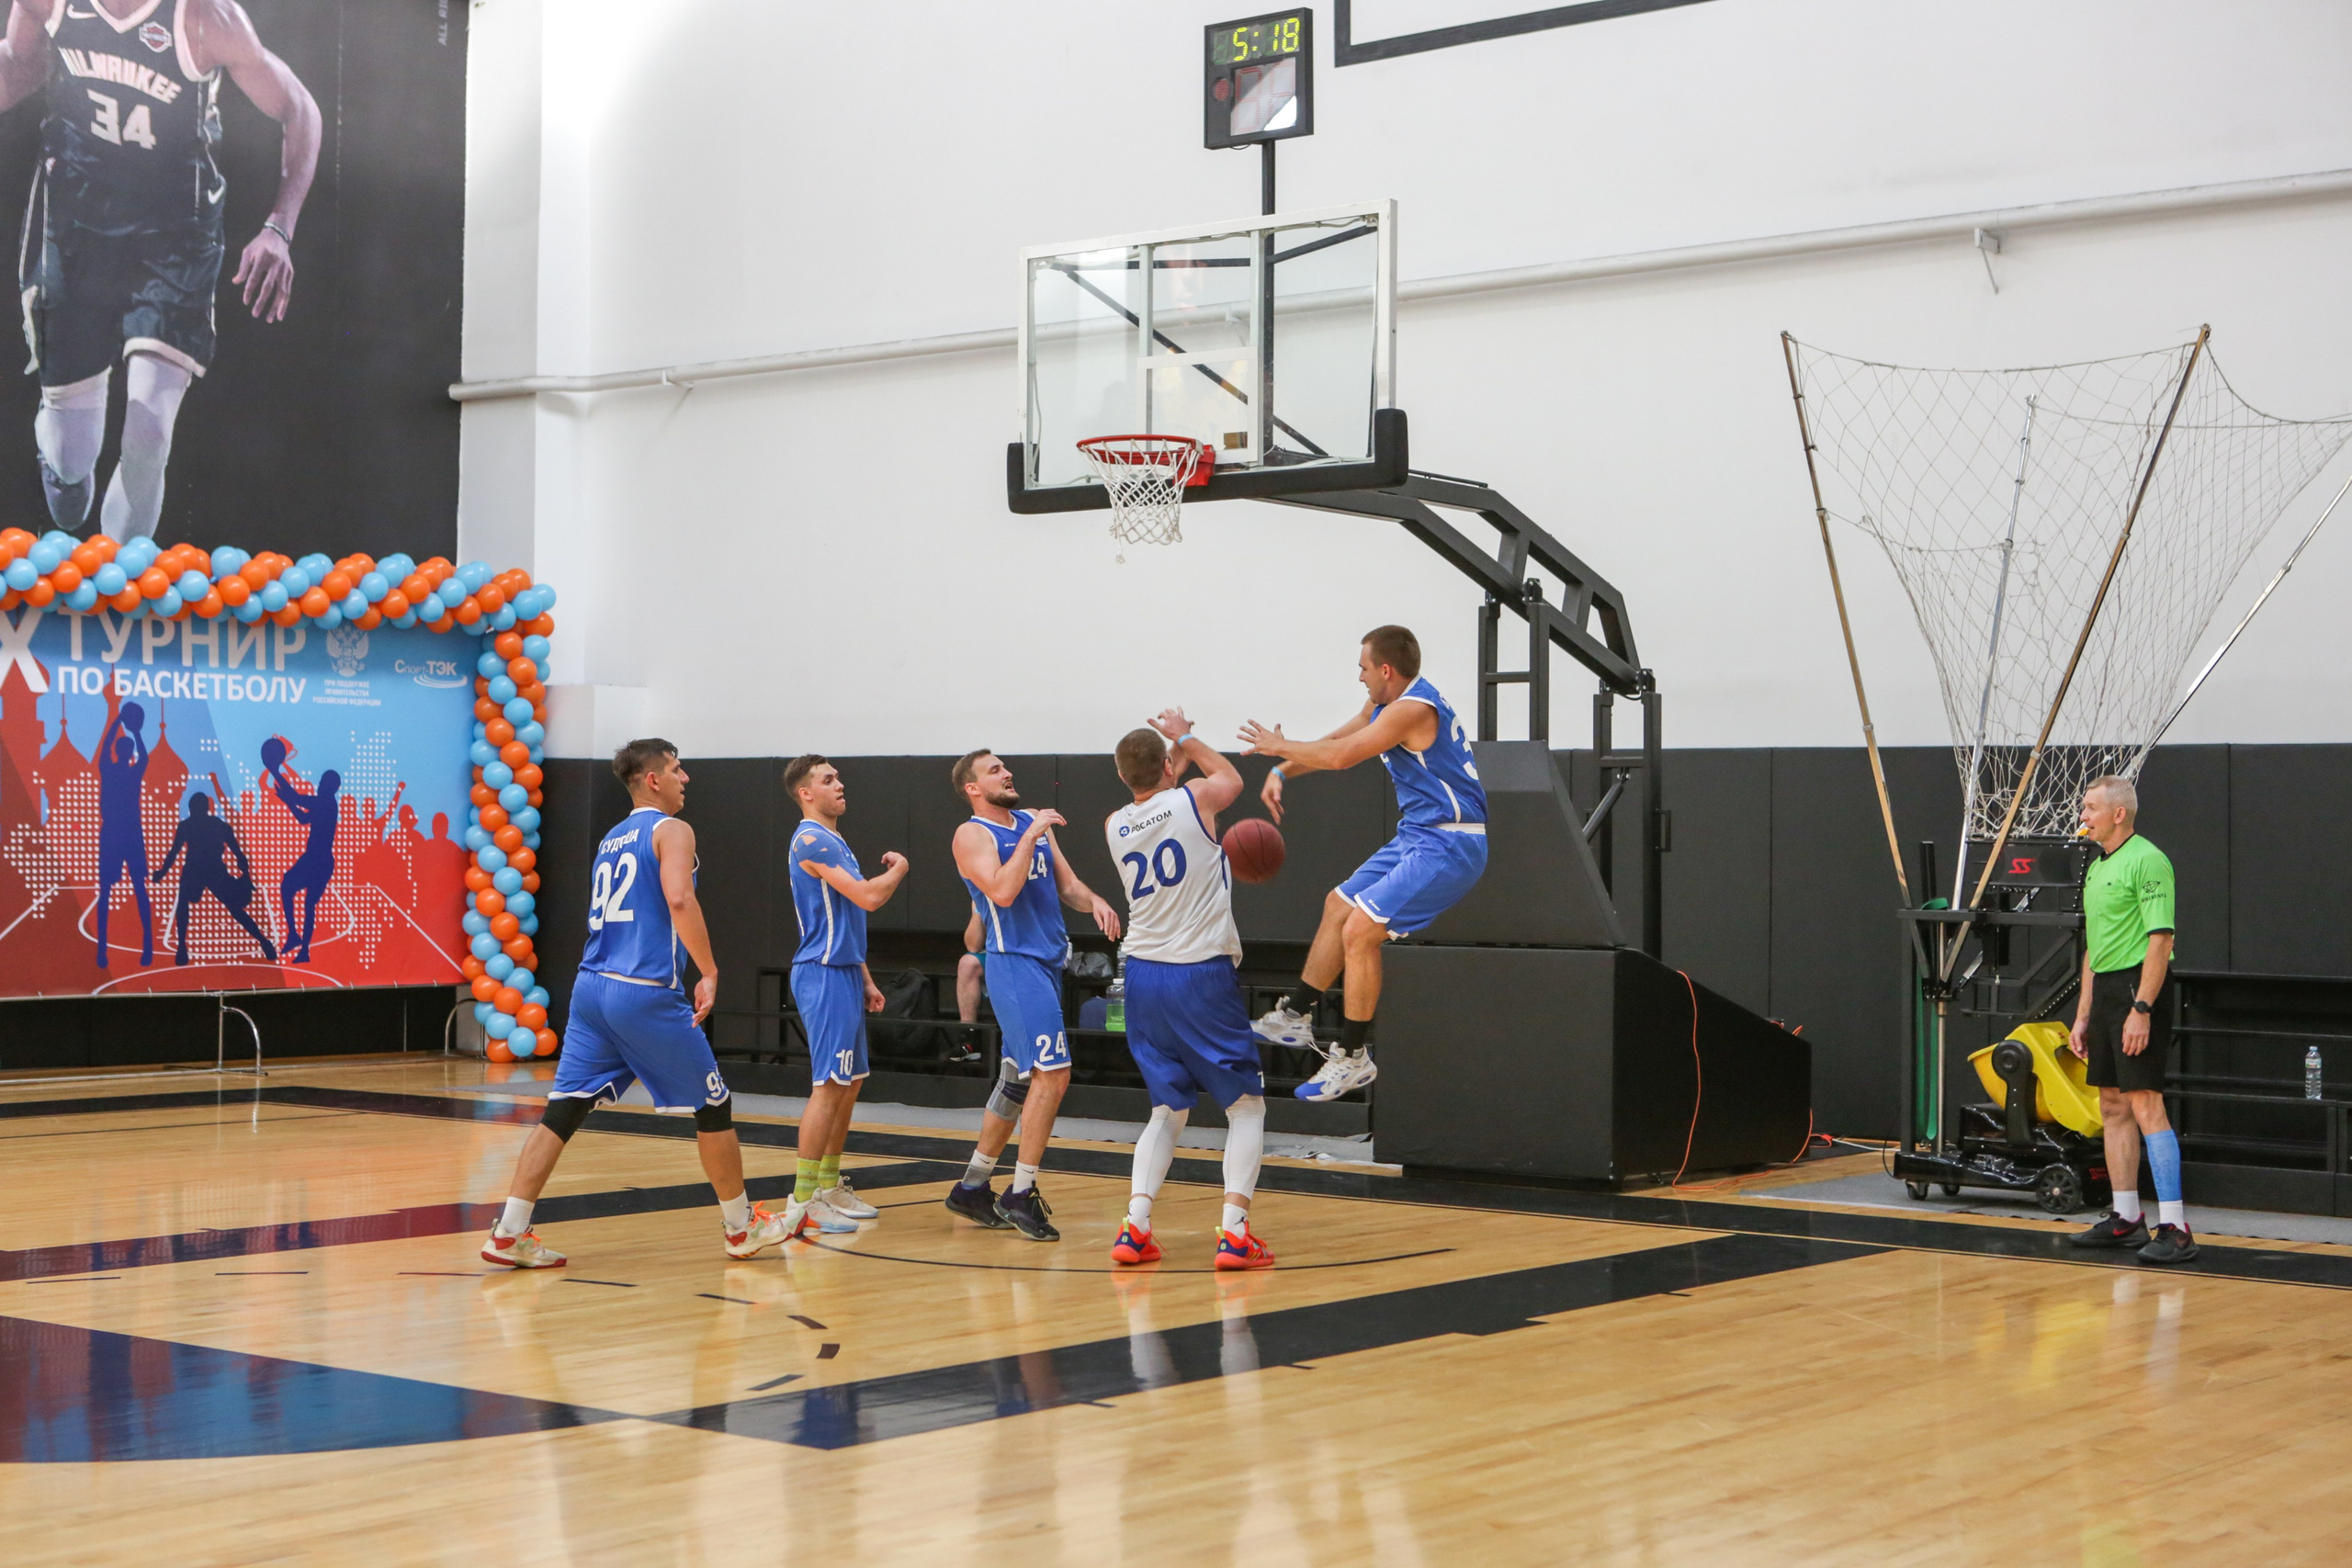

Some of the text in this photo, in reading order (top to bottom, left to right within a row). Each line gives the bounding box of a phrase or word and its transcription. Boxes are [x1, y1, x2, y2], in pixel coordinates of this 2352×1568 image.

[437, 22, 448, 46] ALL
[1233, 17, 1300, 62] 5:18
[86, 89, 157, 150] 34
[57, 606, 307, 671] ТУРНИР
[58, 665, 308, 704] ПО БАСКЕТБОЛУ
[589, 852, 638, 931] 92
[1121, 838, 1187, 900] 20
[836, 1049, 854, 1077] 10
[1035, 1031, 1067, 1063] 24
